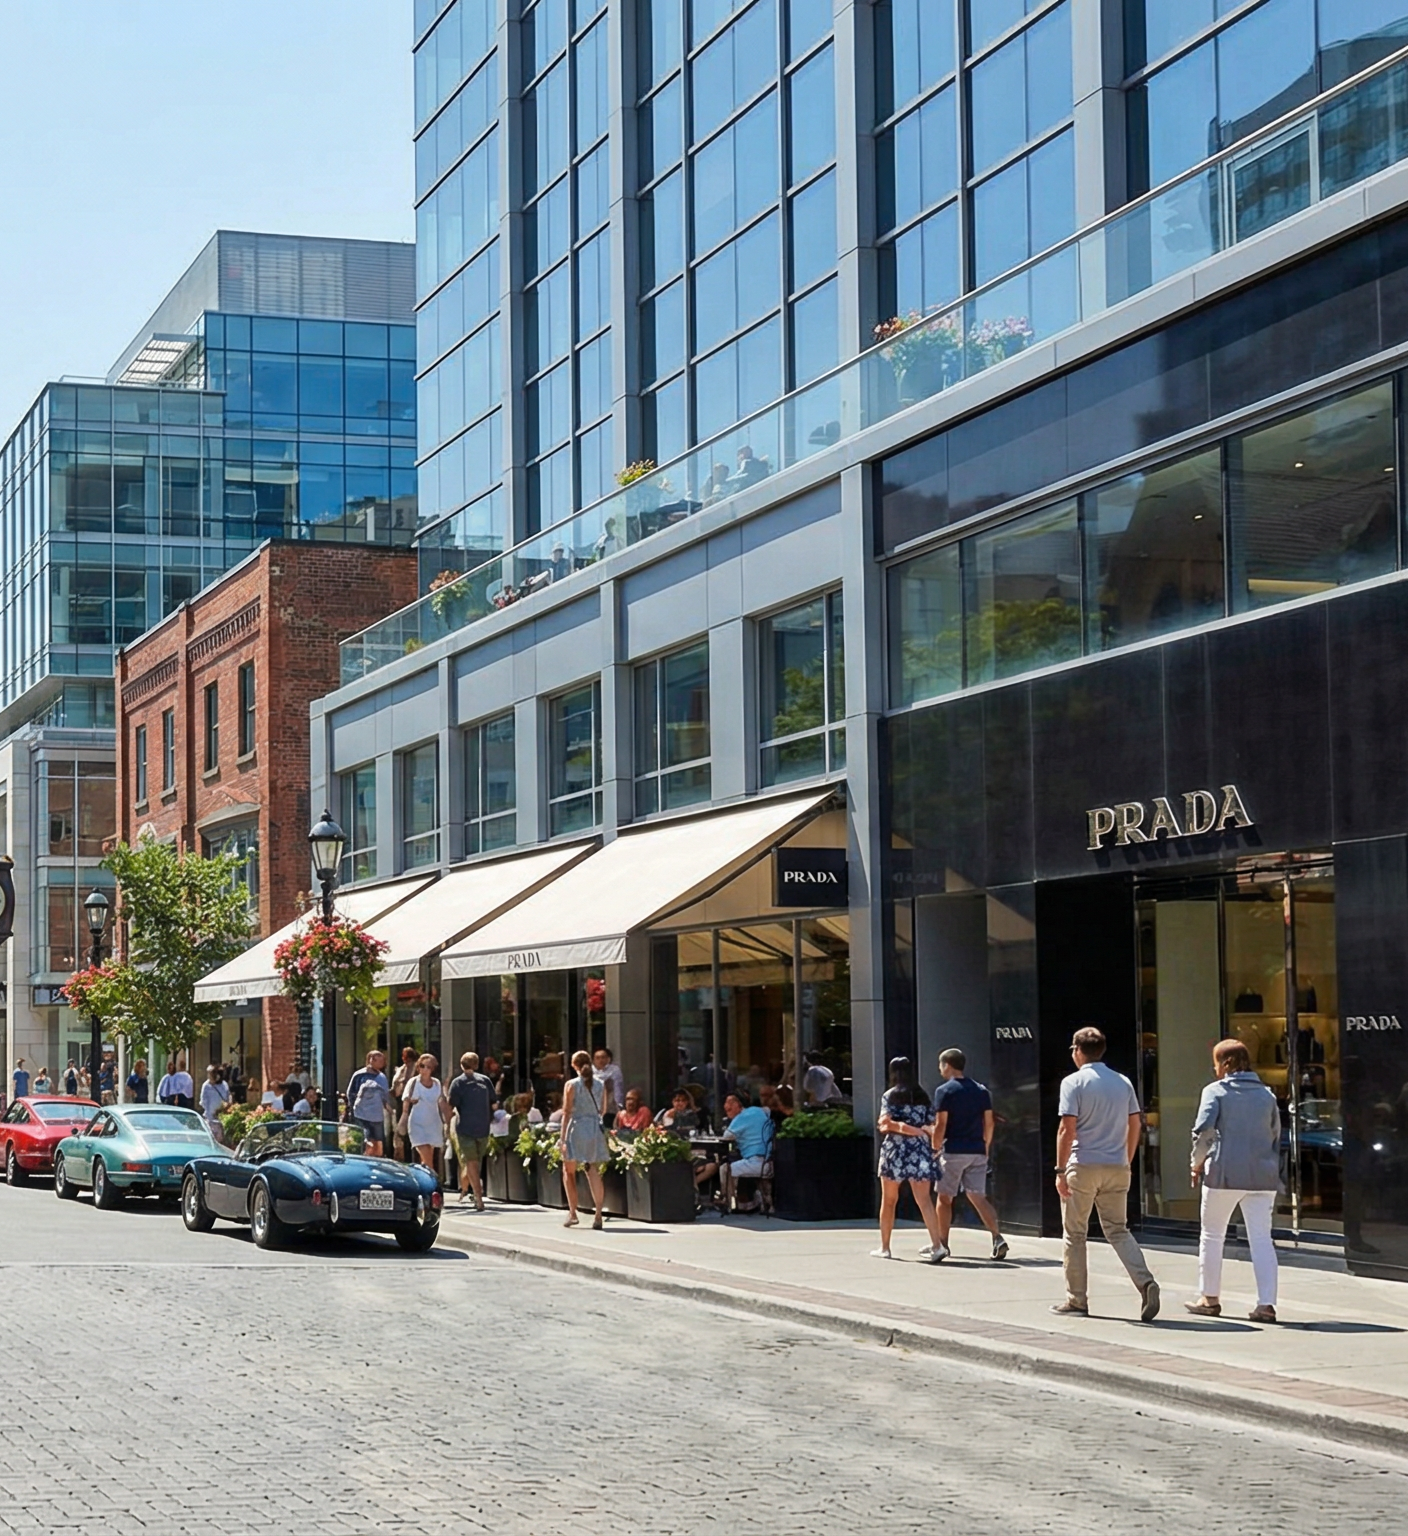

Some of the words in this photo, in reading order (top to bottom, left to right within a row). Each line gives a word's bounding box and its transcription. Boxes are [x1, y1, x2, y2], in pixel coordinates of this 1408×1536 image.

[1086, 784, 1255, 850] PRADA
[784, 871, 838, 883] PRADA
[1346, 1015, 1402, 1031] PRADA
